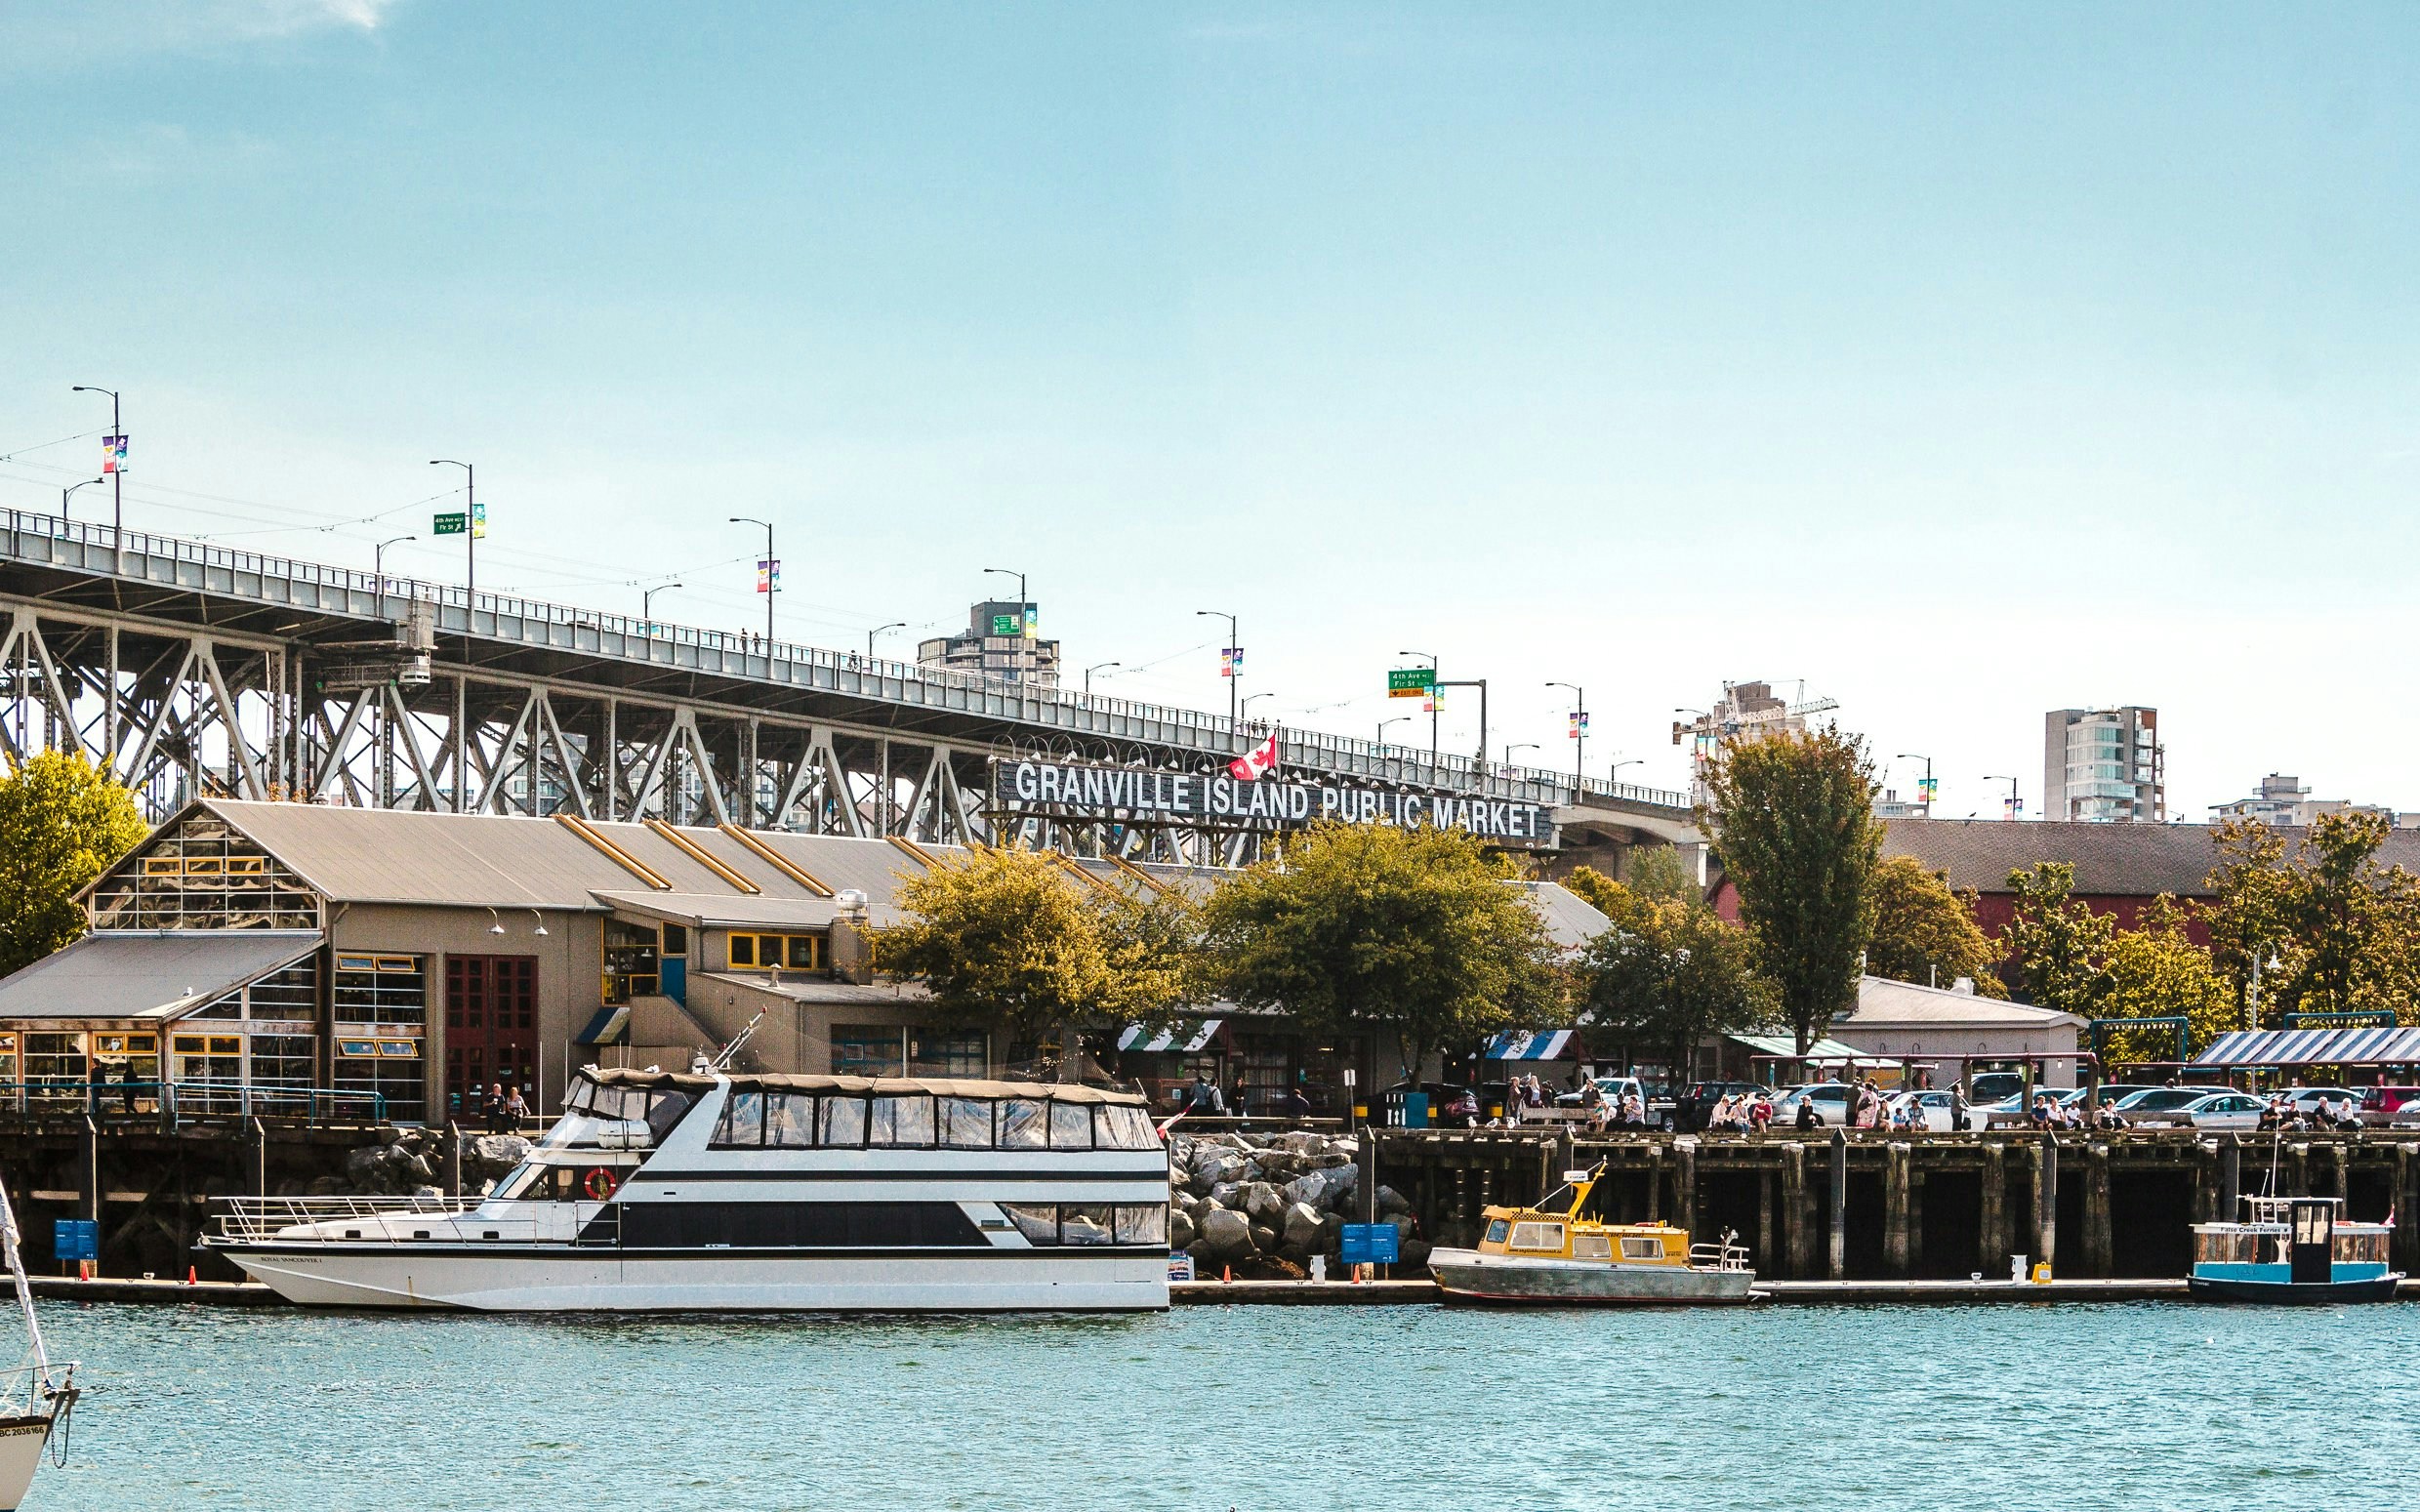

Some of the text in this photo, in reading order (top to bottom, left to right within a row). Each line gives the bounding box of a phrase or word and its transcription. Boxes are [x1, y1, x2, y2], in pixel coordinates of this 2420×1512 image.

[1016, 762, 1539, 838] GRANVILLE ISLAND PUBLIC MARKET
